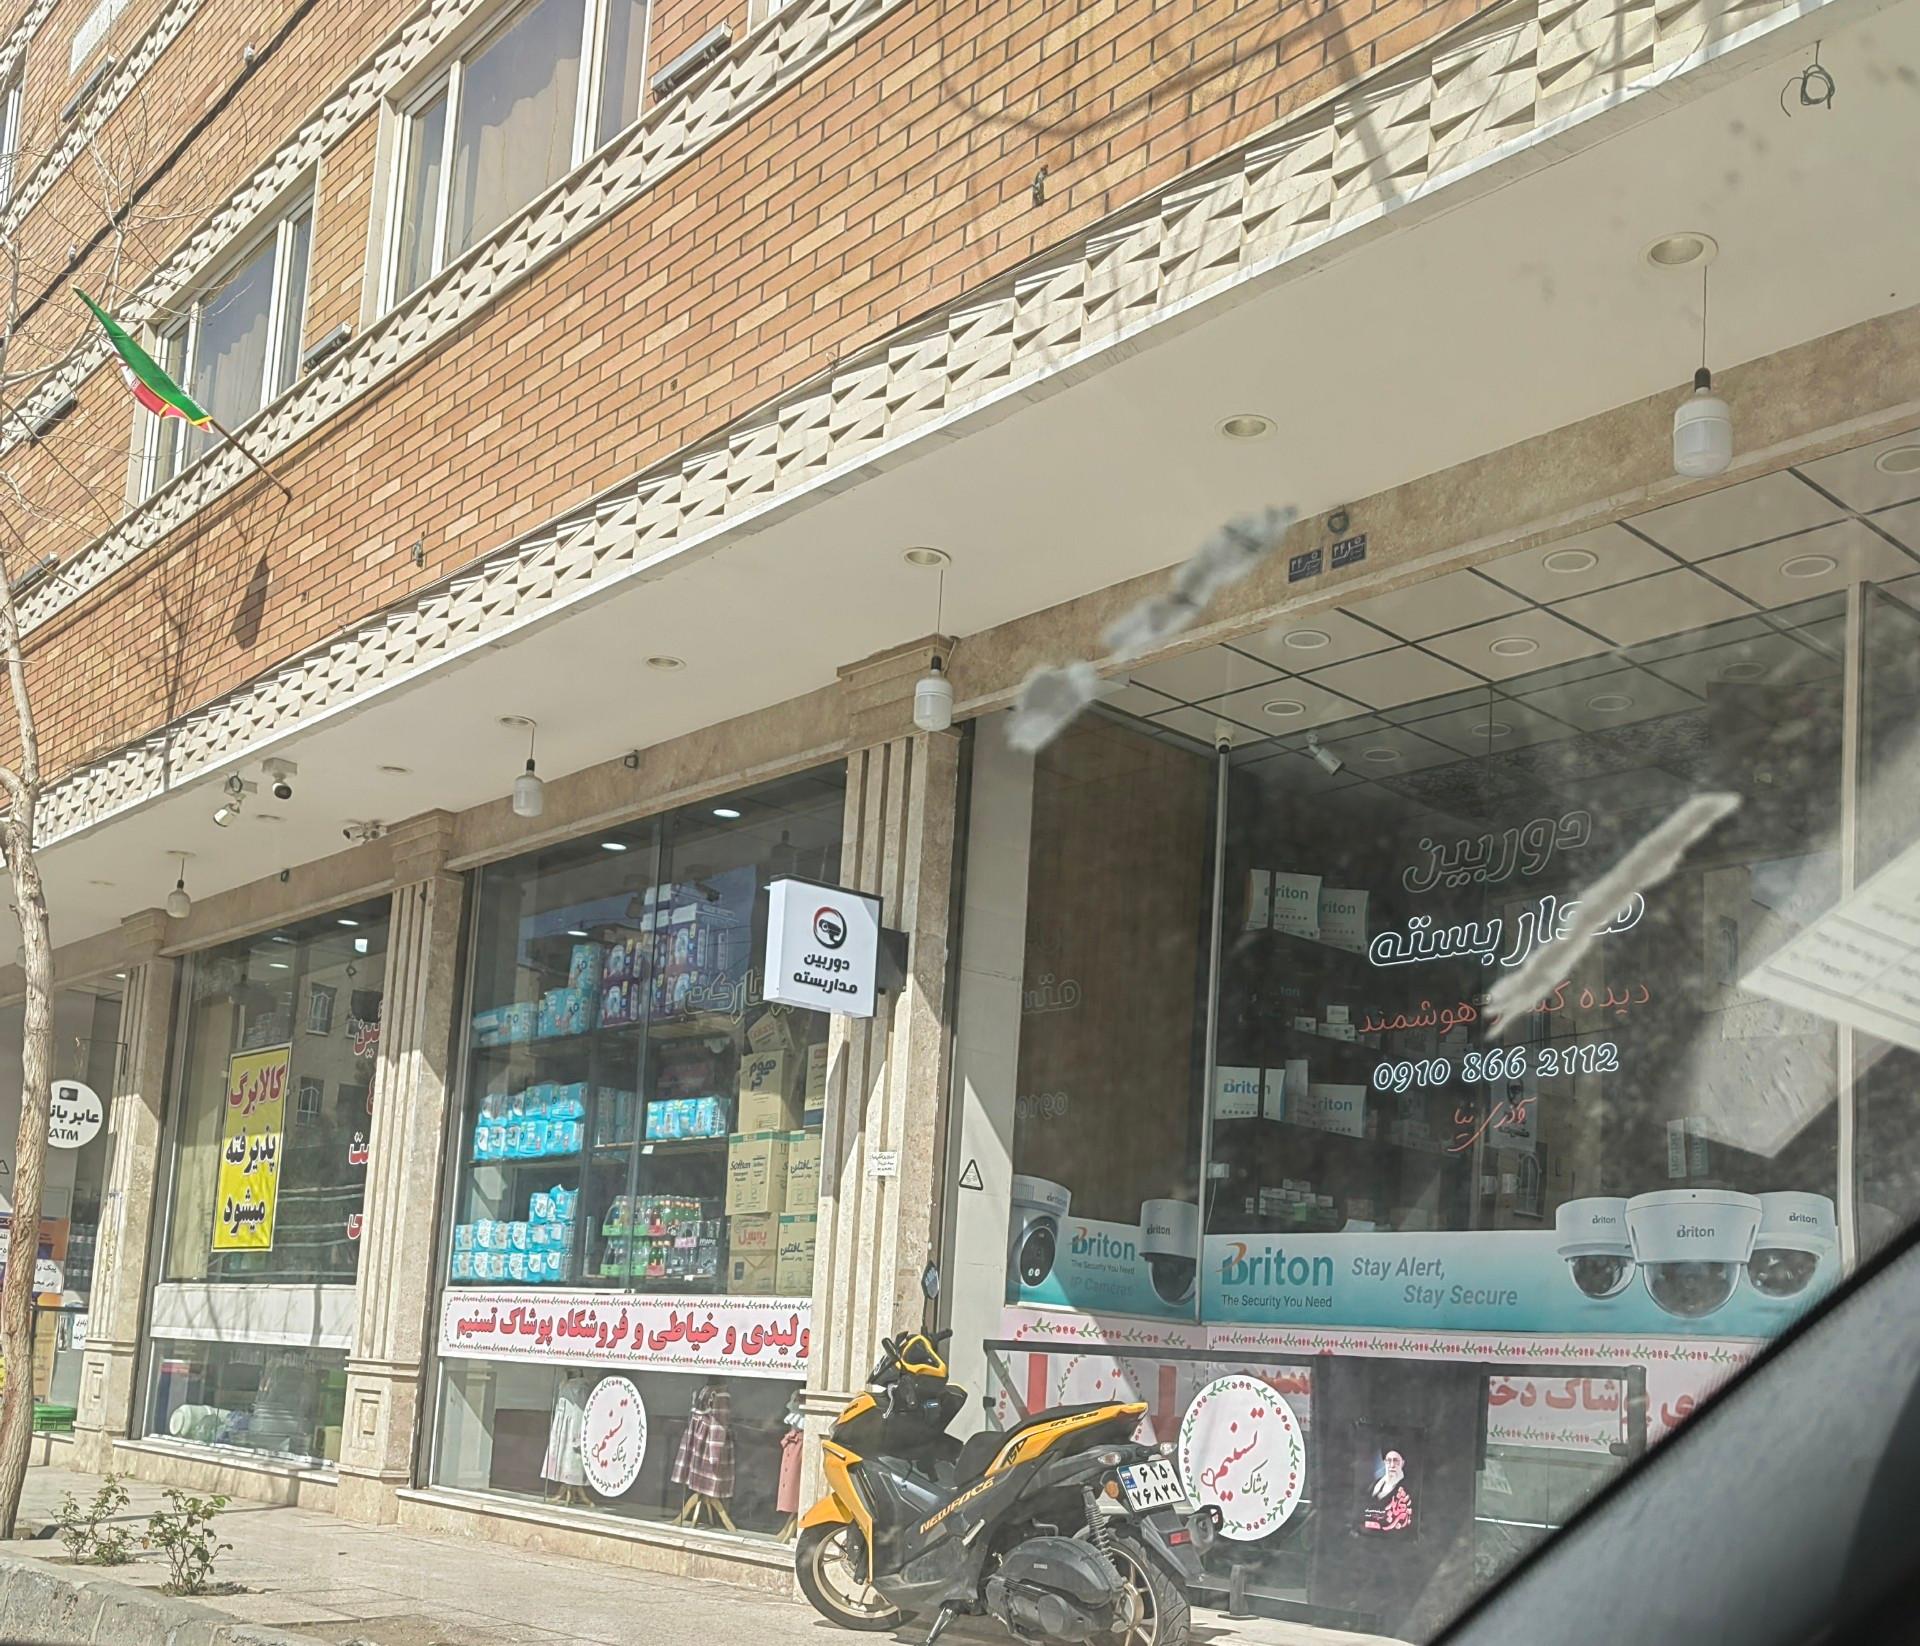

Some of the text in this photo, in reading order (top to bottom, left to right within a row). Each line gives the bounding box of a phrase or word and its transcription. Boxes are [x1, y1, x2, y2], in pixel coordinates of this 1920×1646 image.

[1402, 811, 1591, 893] دوربین
[1322, 902, 1356, 915] riton
[803, 954, 850, 972] دوربین
[1579, 983, 1650, 1015] دیده
[1359, 1000, 1478, 1035] هوشمند
[1374, 1042, 1619, 1093] 0910 866 2112
[230, 1064, 286, 1114] کالابرگ
[1319, 1097, 1353, 1112] riton
[50, 1105, 99, 1125] عابر بان
[49, 1128, 79, 1141] ATM
[226, 1126, 276, 1173] پذیرفته
[224, 1189, 265, 1234] میشود
[1071, 1226, 1136, 1261] Briton
[1217, 1242, 1334, 1287] Briton
[1352, 1257, 1446, 1281] Stay Alert,
[1222, 1295, 1333, 1309] The Security You Need
[1404, 1285, 1518, 1308] Stay Secure
[456, 1307, 811, 1358] ولیدی و خیاطی و فروشگاه پوشاک تسنیم
[1132, 1483, 1182, 1506] ۷۶۸۳۹
[1242, 1459, 1269, 1506] پوشاک
